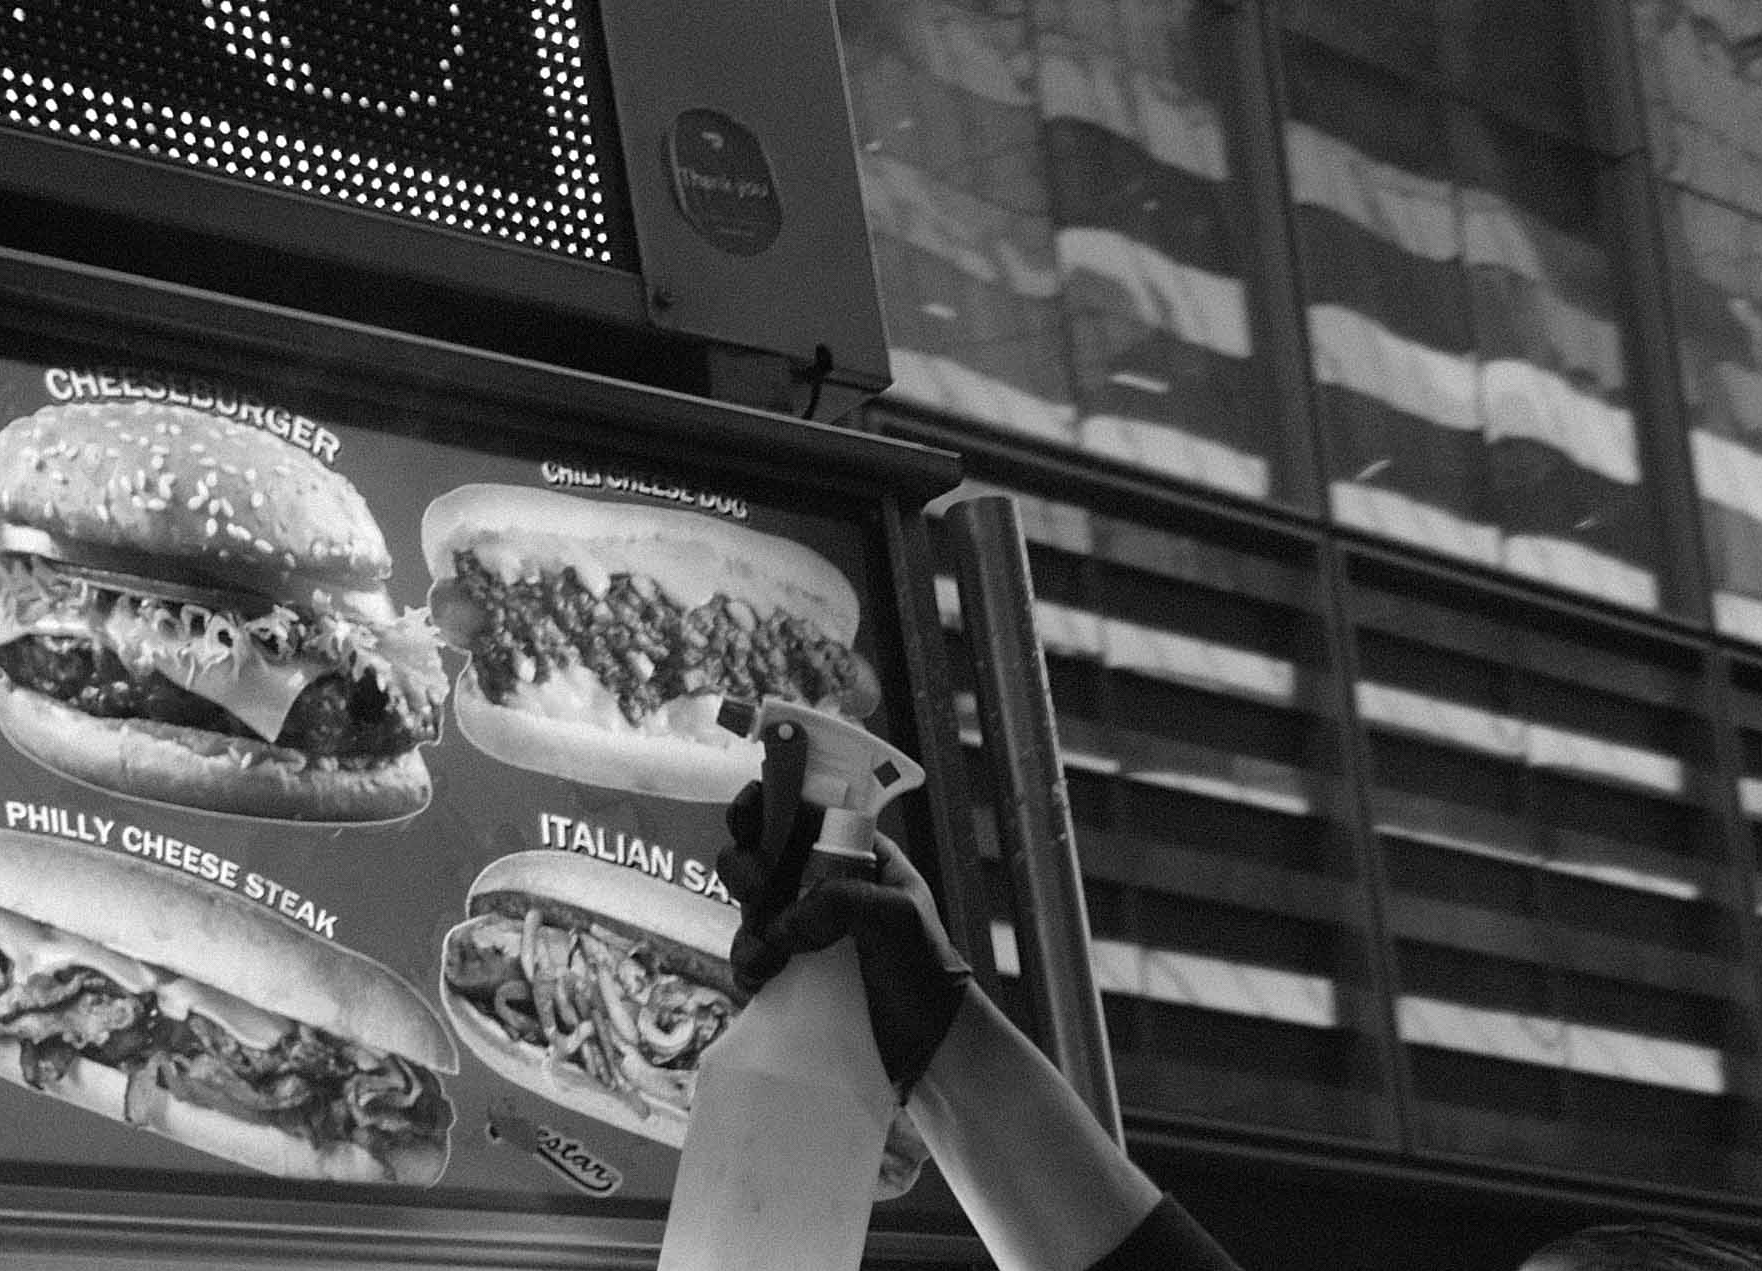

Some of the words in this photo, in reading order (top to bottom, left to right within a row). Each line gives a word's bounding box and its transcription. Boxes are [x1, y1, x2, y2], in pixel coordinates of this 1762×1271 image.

[5, 800, 115, 845] PHILLY
[122, 825, 241, 890] CHEESE
[244, 871, 339, 939] STEAK
[540, 812, 675, 882] ITALIAN
[682, 858, 741, 907] SA
